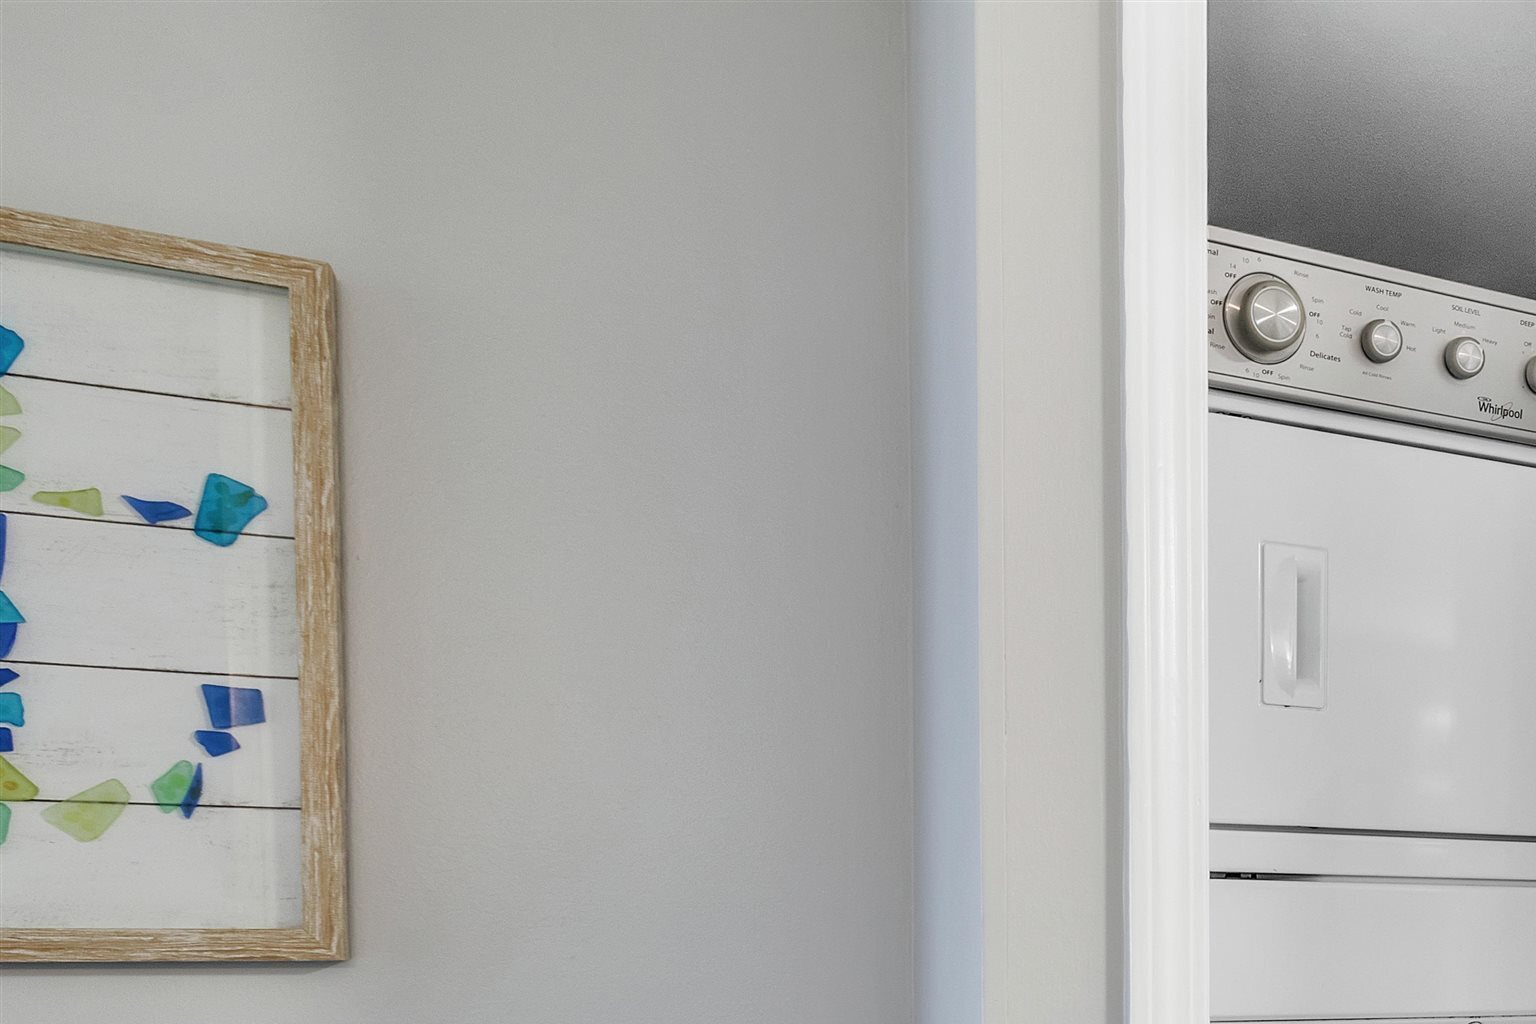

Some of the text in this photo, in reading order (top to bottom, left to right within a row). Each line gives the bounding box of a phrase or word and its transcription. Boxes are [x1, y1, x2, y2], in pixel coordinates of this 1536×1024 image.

[1365, 285, 1402, 298] WASH TEMP
[1349, 308, 1362, 316] Cold
[1452, 304, 1480, 316] SOIL LEVEL
[1432, 327, 1446, 335] Light
[1454, 321, 1476, 330] Medium
[1310, 350, 1341, 362] Delicates
[1478, 401, 1522, 420] Whirlpool
